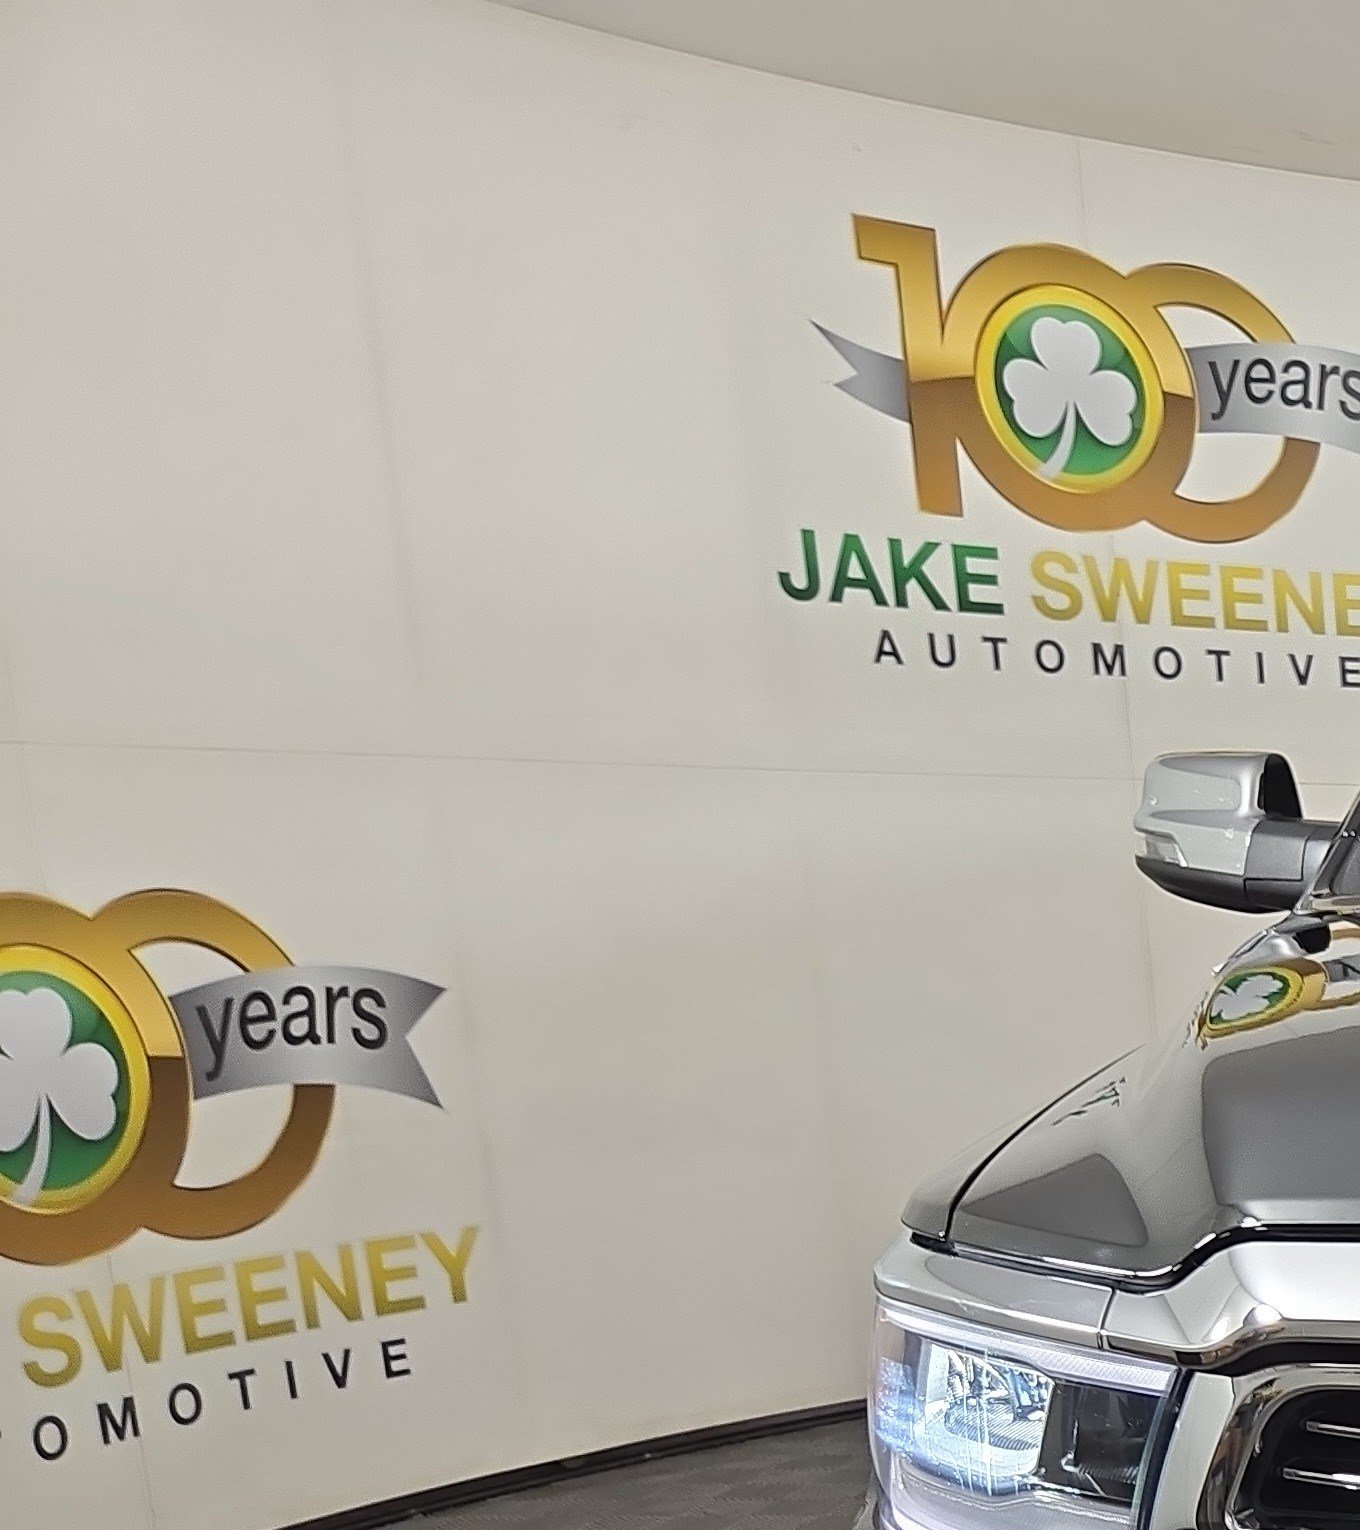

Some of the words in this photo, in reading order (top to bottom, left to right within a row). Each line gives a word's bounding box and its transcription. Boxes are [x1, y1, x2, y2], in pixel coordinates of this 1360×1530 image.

[777, 528, 1005, 616] JAKE
[195, 982, 389, 1081] years
[18, 1224, 481, 1389] SWEENEY
[0, 1338, 412, 1461] OMOTIVE
